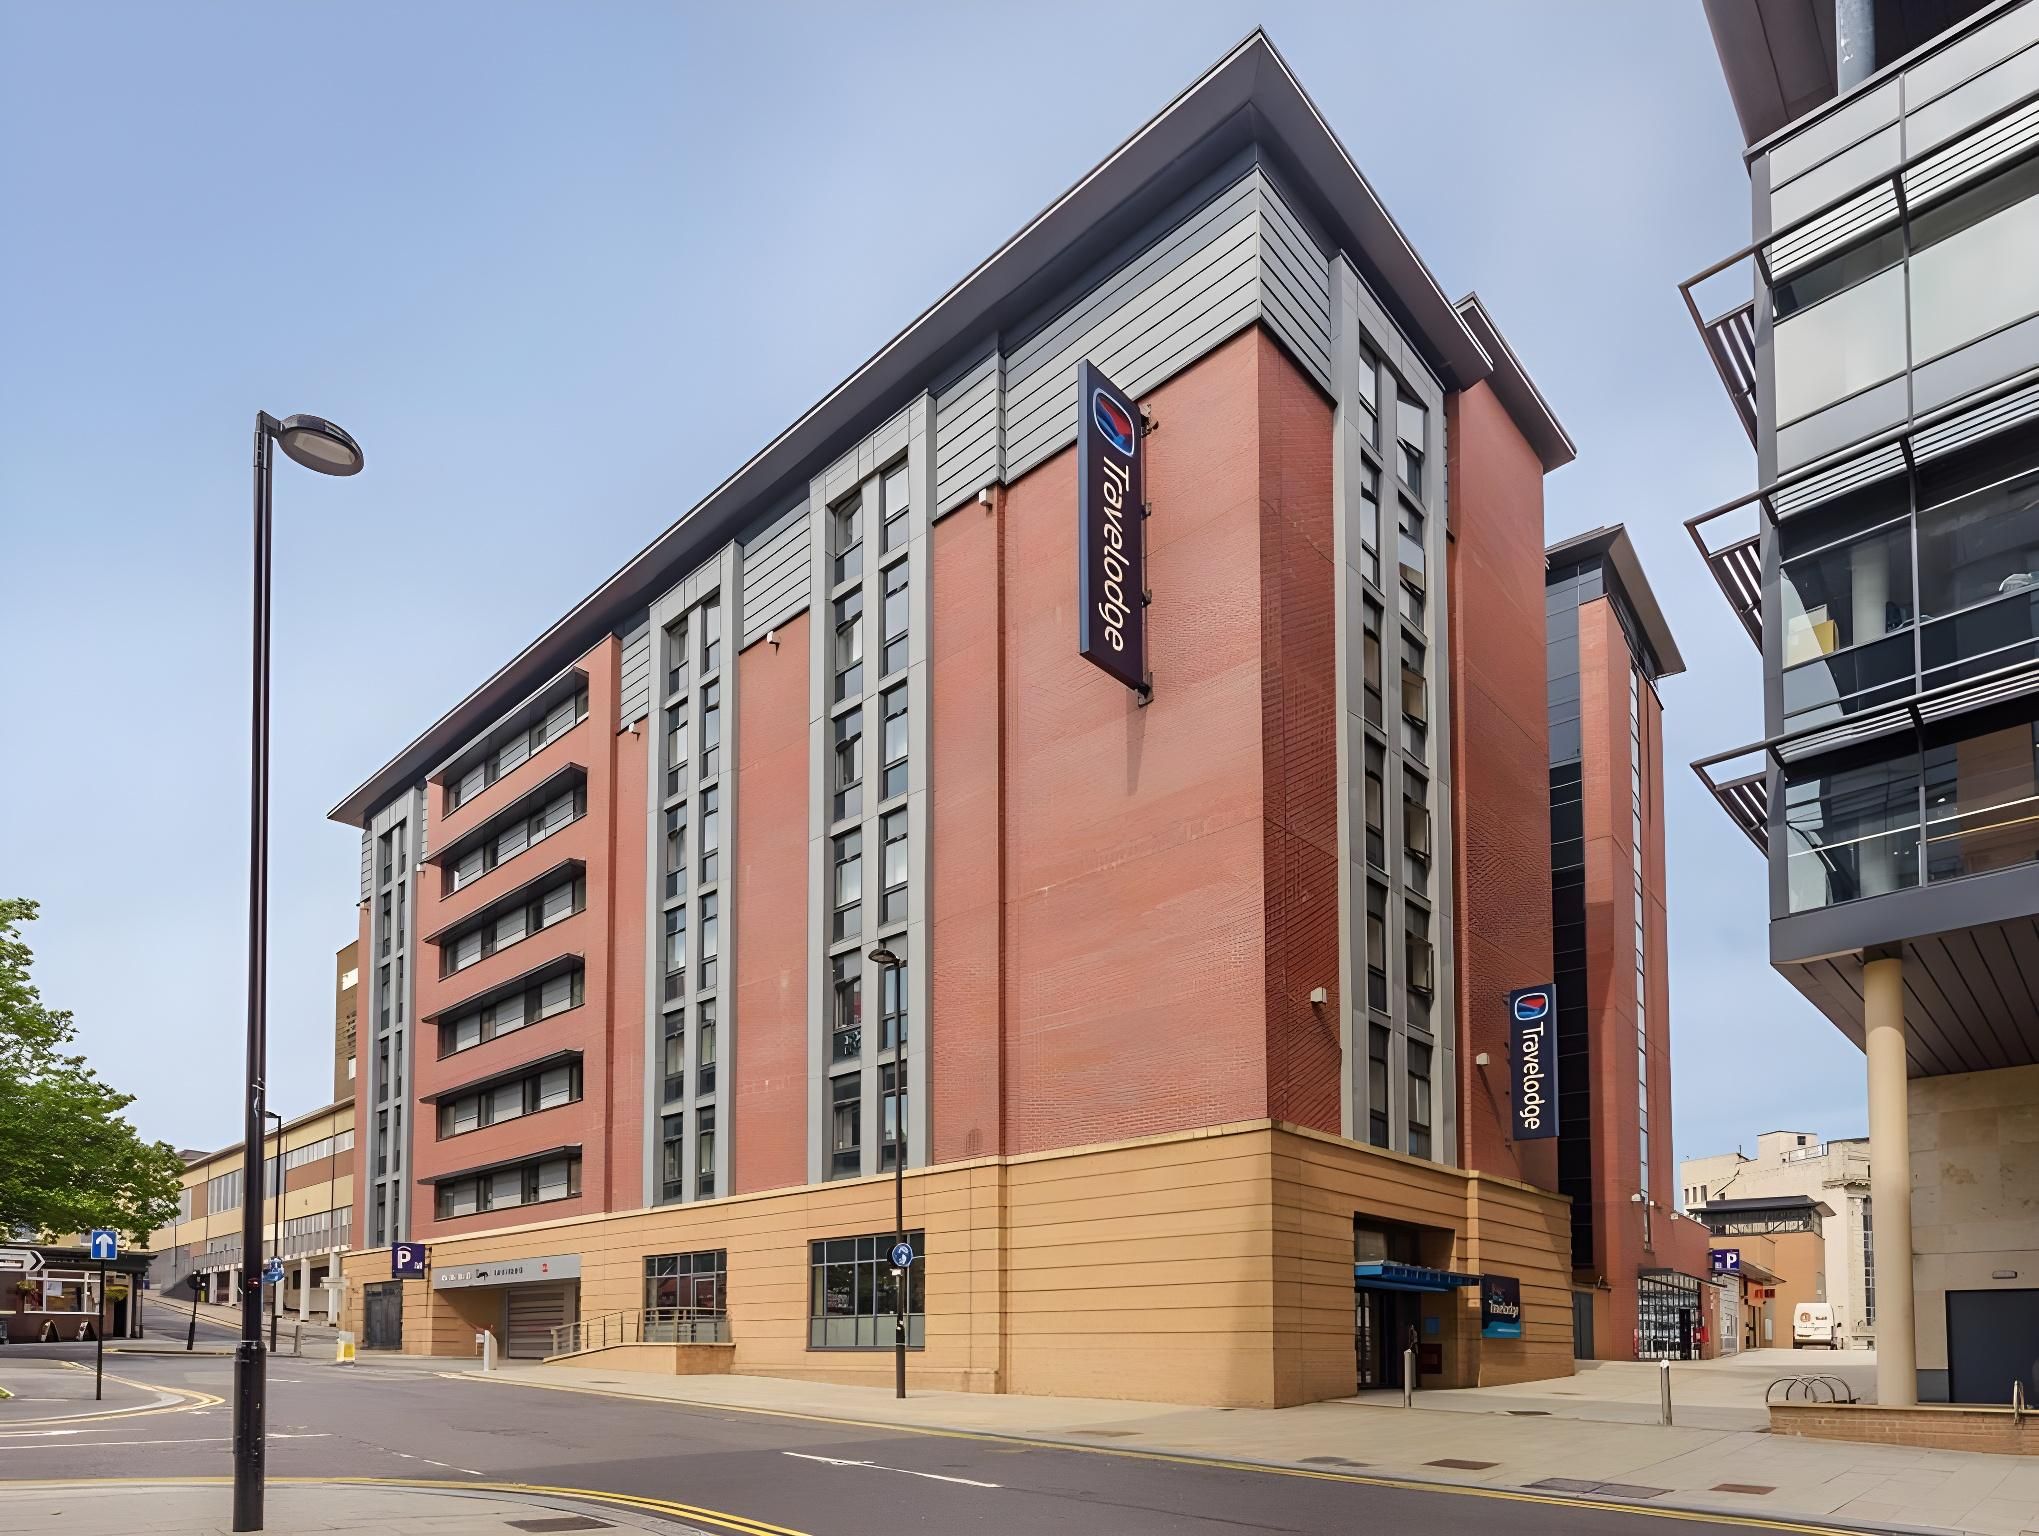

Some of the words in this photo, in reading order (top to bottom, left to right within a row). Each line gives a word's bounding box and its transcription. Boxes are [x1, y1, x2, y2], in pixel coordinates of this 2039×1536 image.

[1100, 457, 1131, 651] Travelodge
[1520, 1022, 1545, 1129] Travelodge
[398, 1250, 411, 1268] P
[1726, 1252, 1737, 1269] P
